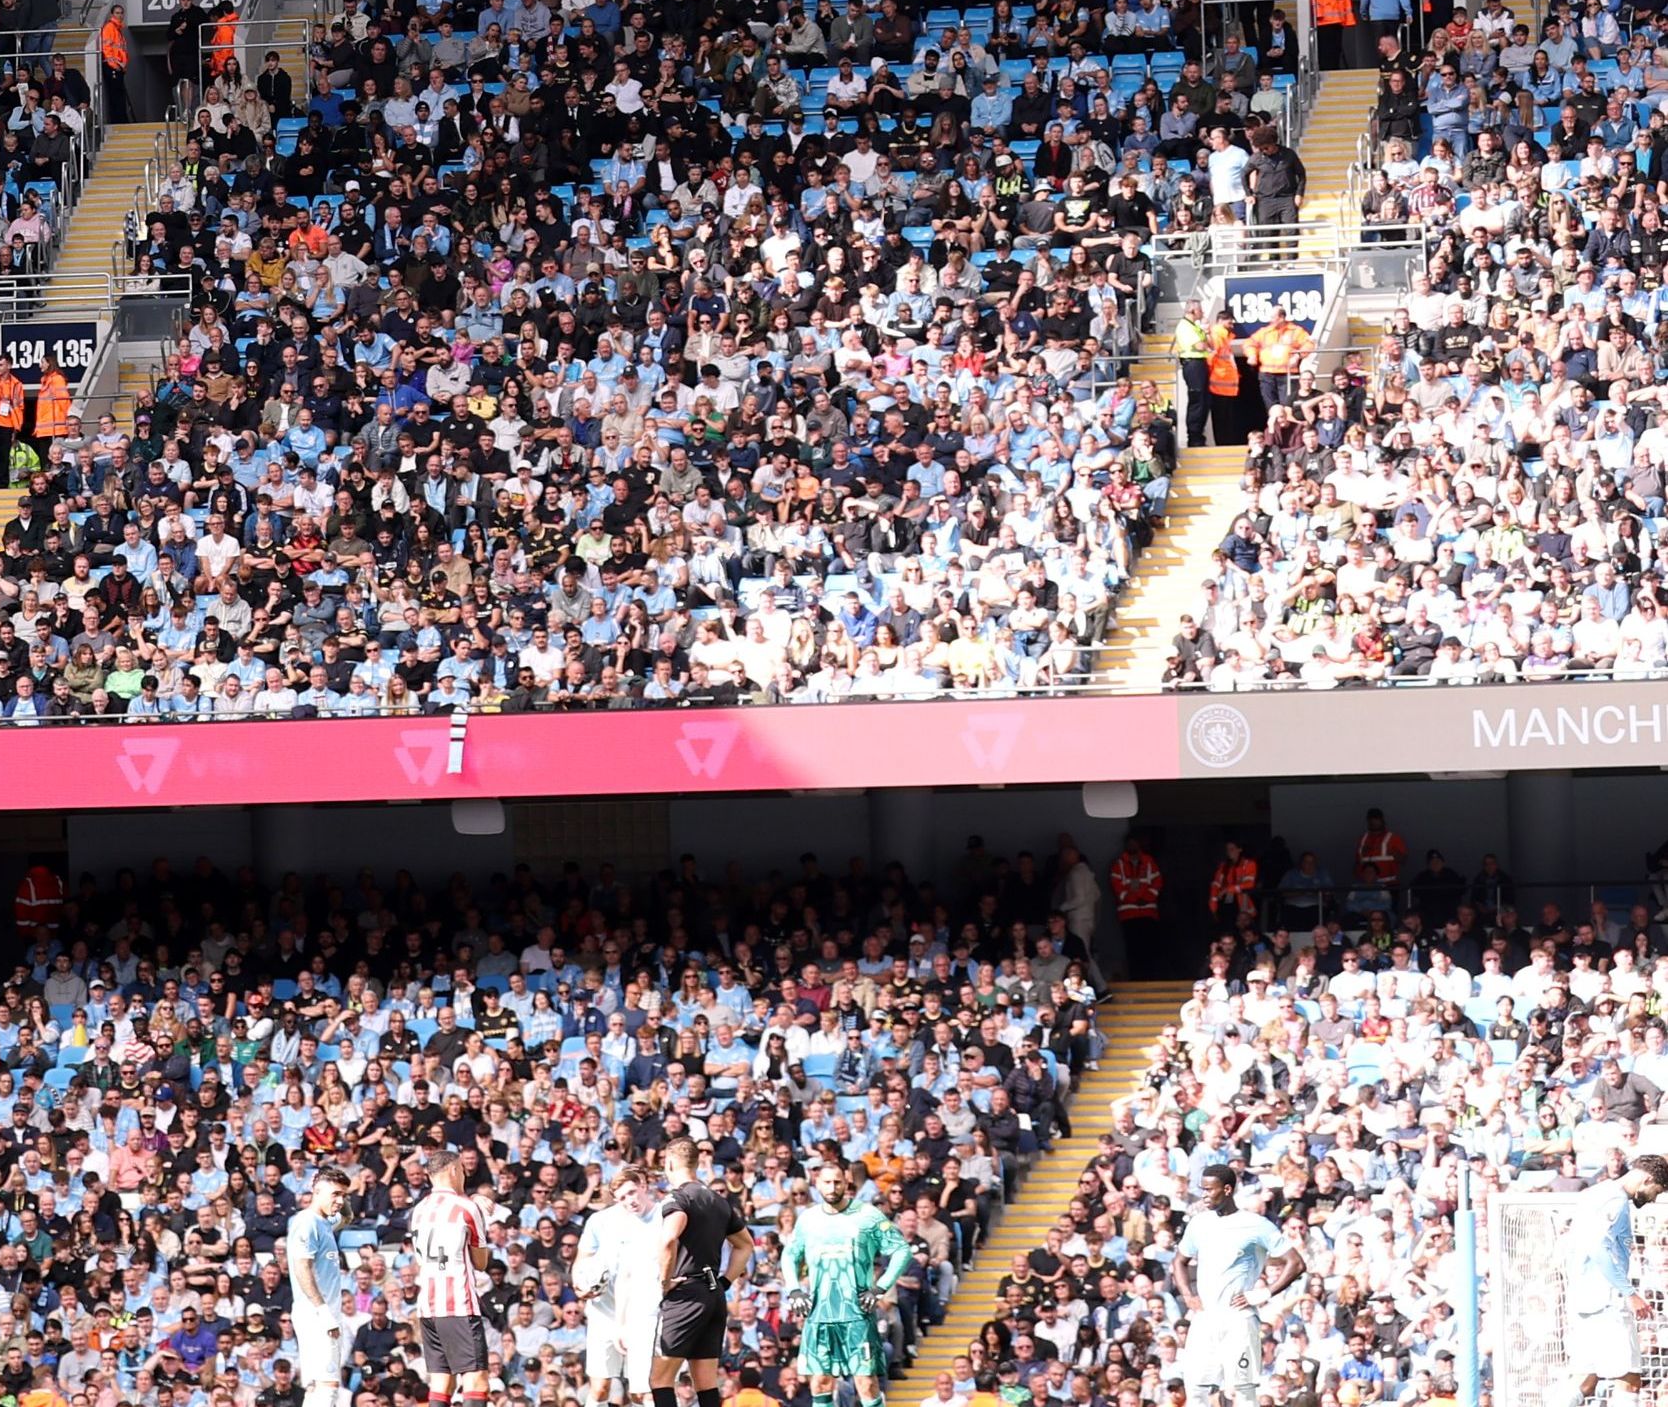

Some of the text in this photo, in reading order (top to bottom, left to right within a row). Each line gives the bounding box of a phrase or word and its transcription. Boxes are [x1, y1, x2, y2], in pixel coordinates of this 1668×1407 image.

[1229, 290, 1322, 323] 135 136
[6, 338, 94, 369] 134 135
[1472, 703, 1668, 748] MANCH
[1238, 1351, 1250, 1369] 6
